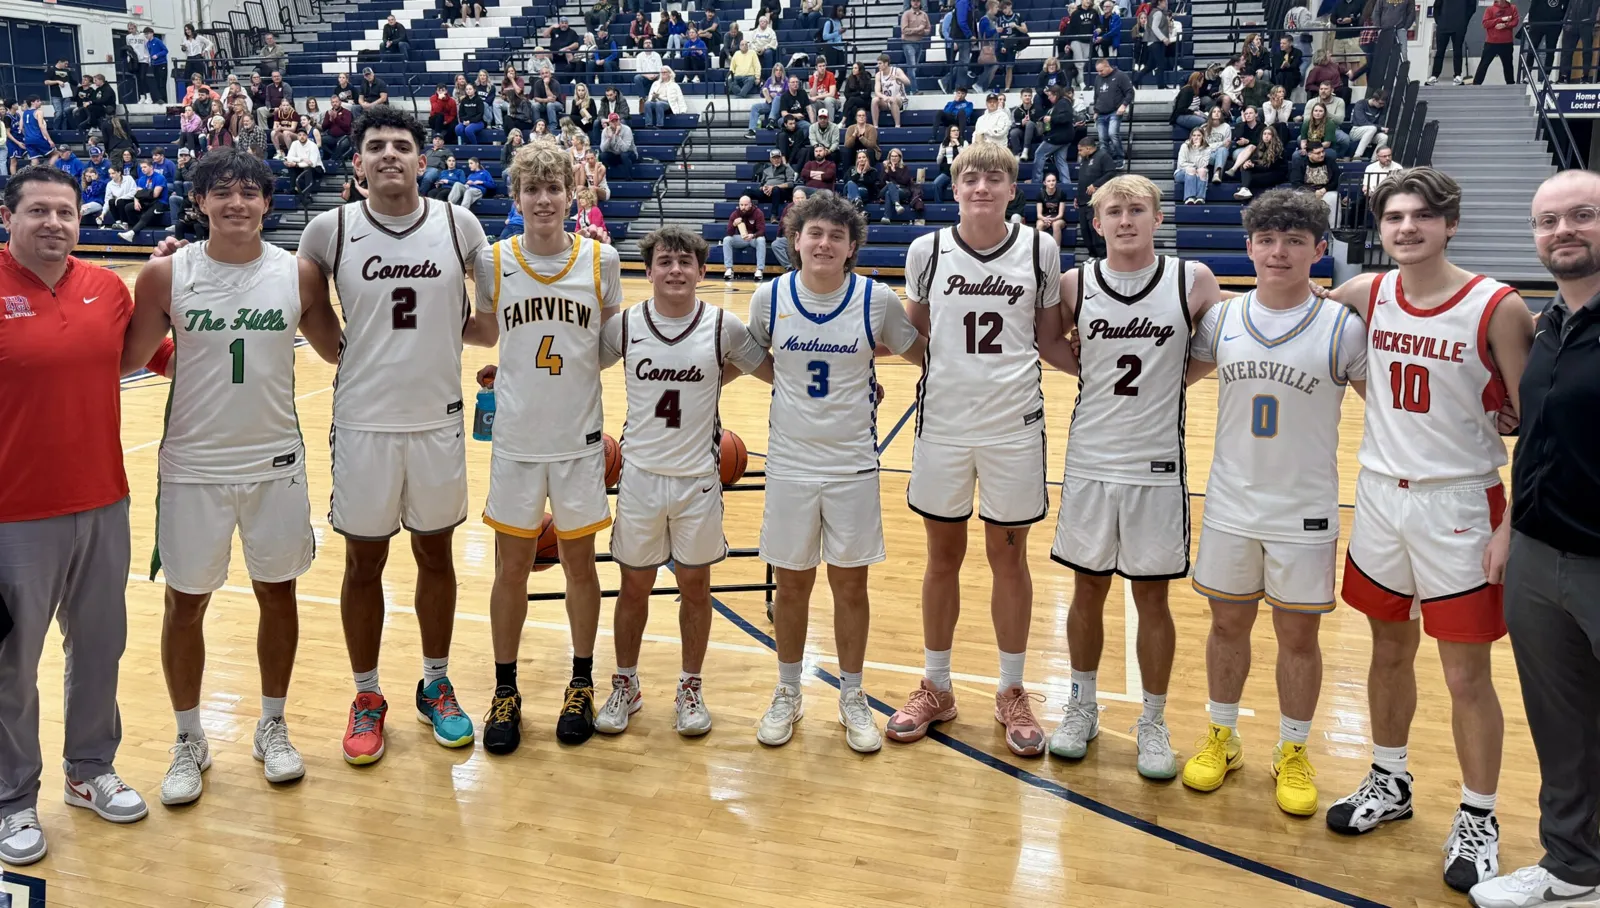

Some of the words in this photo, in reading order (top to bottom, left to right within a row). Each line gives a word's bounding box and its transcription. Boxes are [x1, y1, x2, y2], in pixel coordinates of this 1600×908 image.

[1570, 101, 1596, 109] Locker
[1575, 92, 1596, 100] Home
[361, 255, 442, 281] Comets
[943, 274, 1025, 306] Paulding
[184, 308, 227, 332] The
[230, 308, 288, 332] Hills
[391, 286, 418, 331] 2
[503, 297, 592, 332] FAIRVIEW
[779, 335, 859, 354] Northwood
[963, 311, 1004, 354] 12
[1086, 317, 1175, 347] Paulding
[1372, 329, 1467, 364] HICKSVILLE
[229, 338, 245, 384] 1
[535, 335, 563, 376] 4
[635, 358, 705, 382] Comets
[807, 360, 830, 398] 3
[1113, 354, 1142, 397] 2
[1221, 360, 1321, 396] AYERSVILLE
[1389, 361, 1431, 414] 10
[482, 412, 495, 425] G
[654, 389, 682, 429] 4
[1251, 393, 1280, 439] 0
